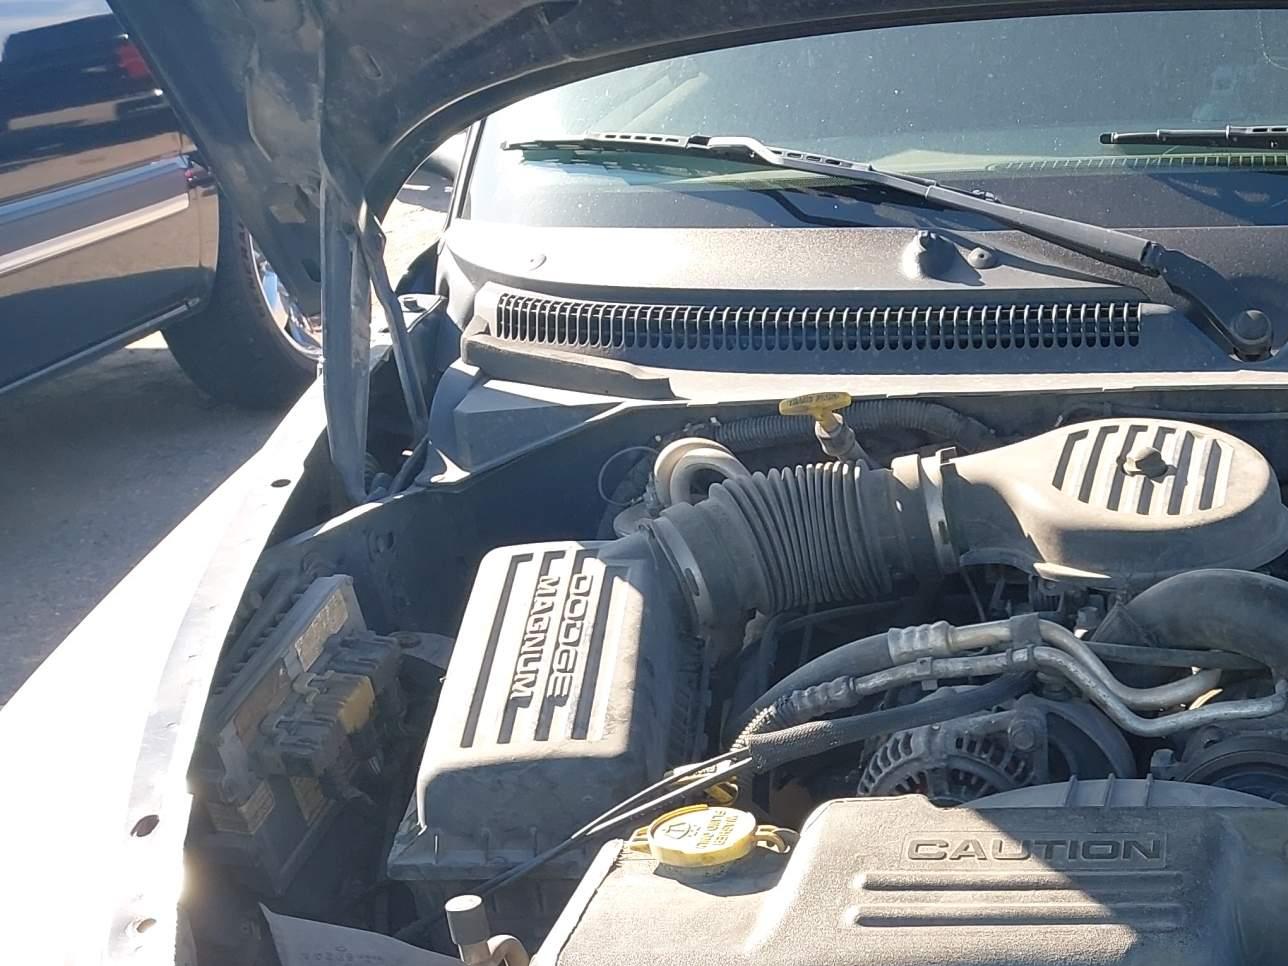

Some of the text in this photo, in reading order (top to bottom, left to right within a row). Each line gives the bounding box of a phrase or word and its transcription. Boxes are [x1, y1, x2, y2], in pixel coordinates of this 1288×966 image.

[509, 575, 561, 701] MAGNUM
[547, 573, 594, 700] DODGE
[907, 838, 1161, 861] CAUTION
